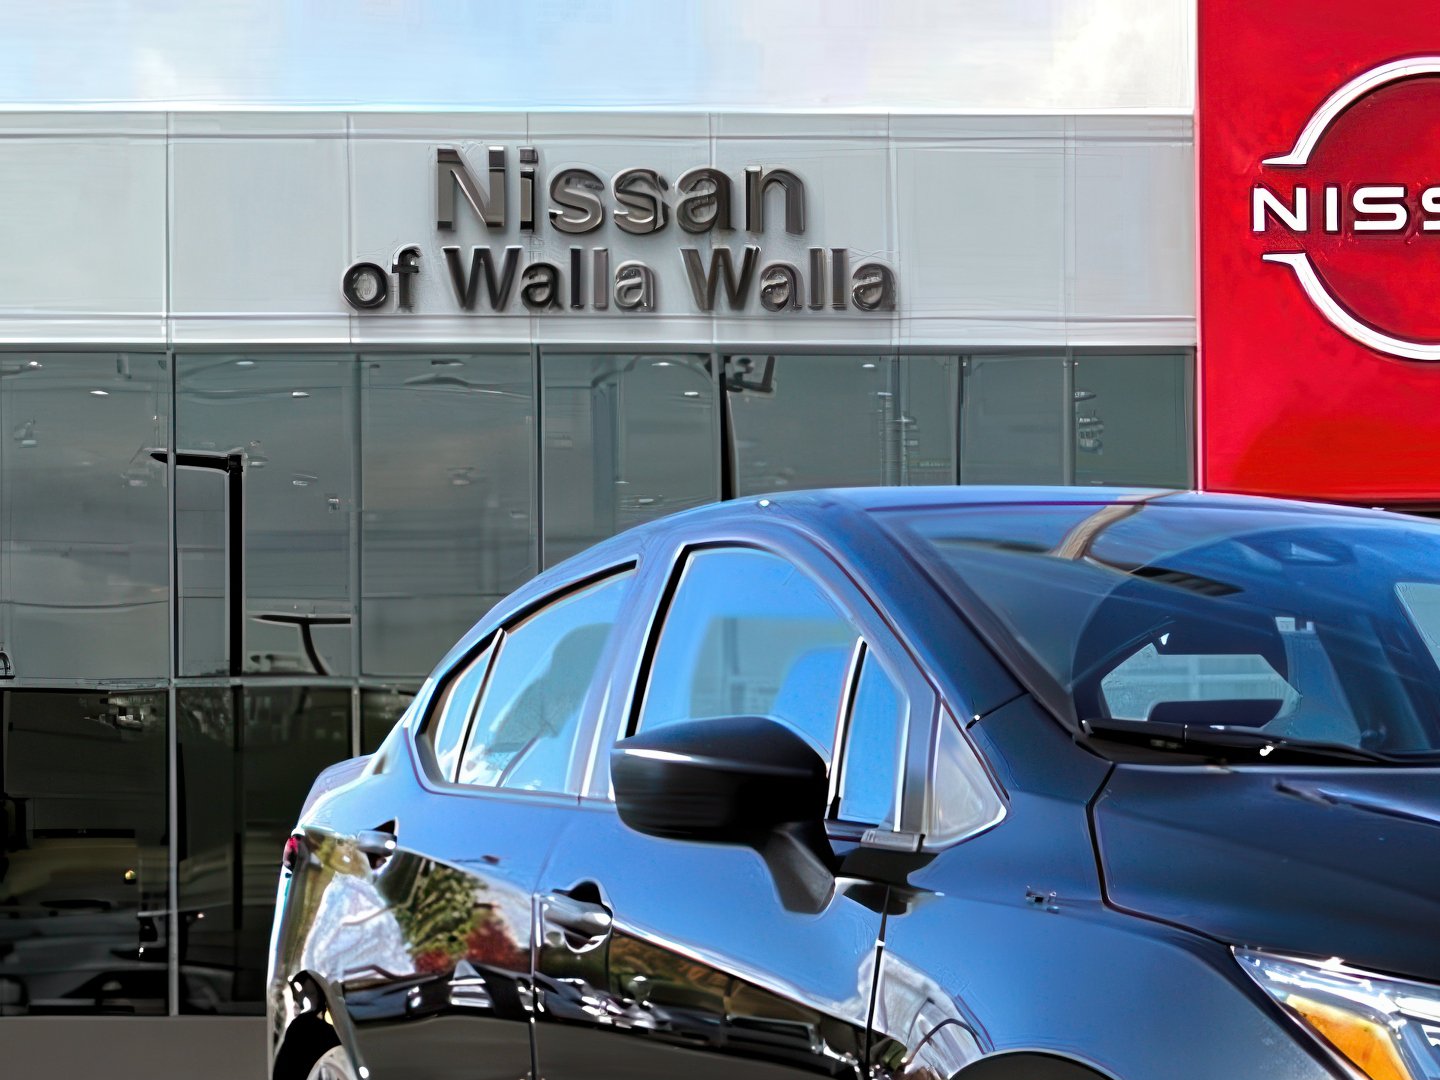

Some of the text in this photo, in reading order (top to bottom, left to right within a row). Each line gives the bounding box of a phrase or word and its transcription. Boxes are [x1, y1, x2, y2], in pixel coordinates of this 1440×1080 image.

[436, 146, 806, 234] Nissan
[342, 244, 897, 311] of Walla Walla
